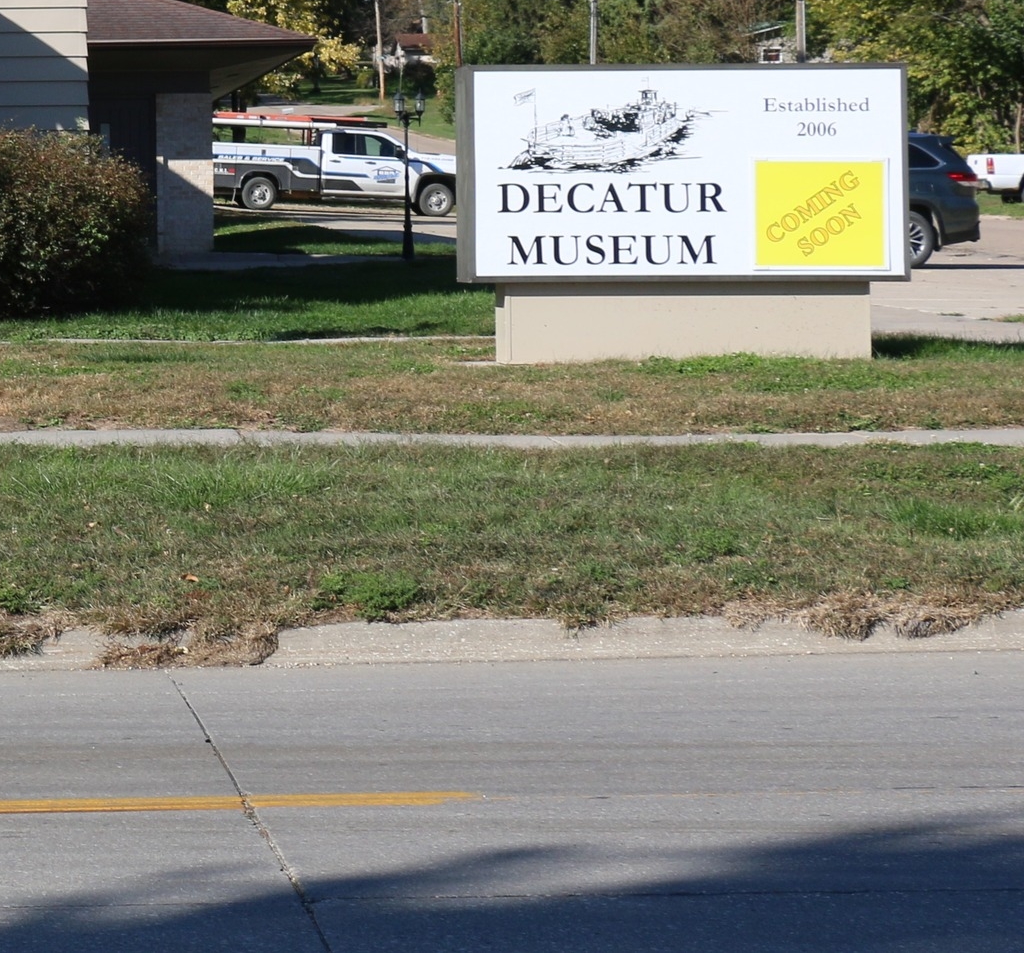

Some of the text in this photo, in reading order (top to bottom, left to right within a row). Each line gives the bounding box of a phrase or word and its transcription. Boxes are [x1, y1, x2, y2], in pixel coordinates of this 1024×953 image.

[763, 97, 870, 112] Established
[797, 121, 837, 137] 2006
[251, 155, 285, 163] SERVICE
[497, 183, 727, 213] DECATUR
[766, 170, 861, 243] COMING
[796, 203, 862, 257] SOON
[507, 234, 717, 266] MUSEUM
